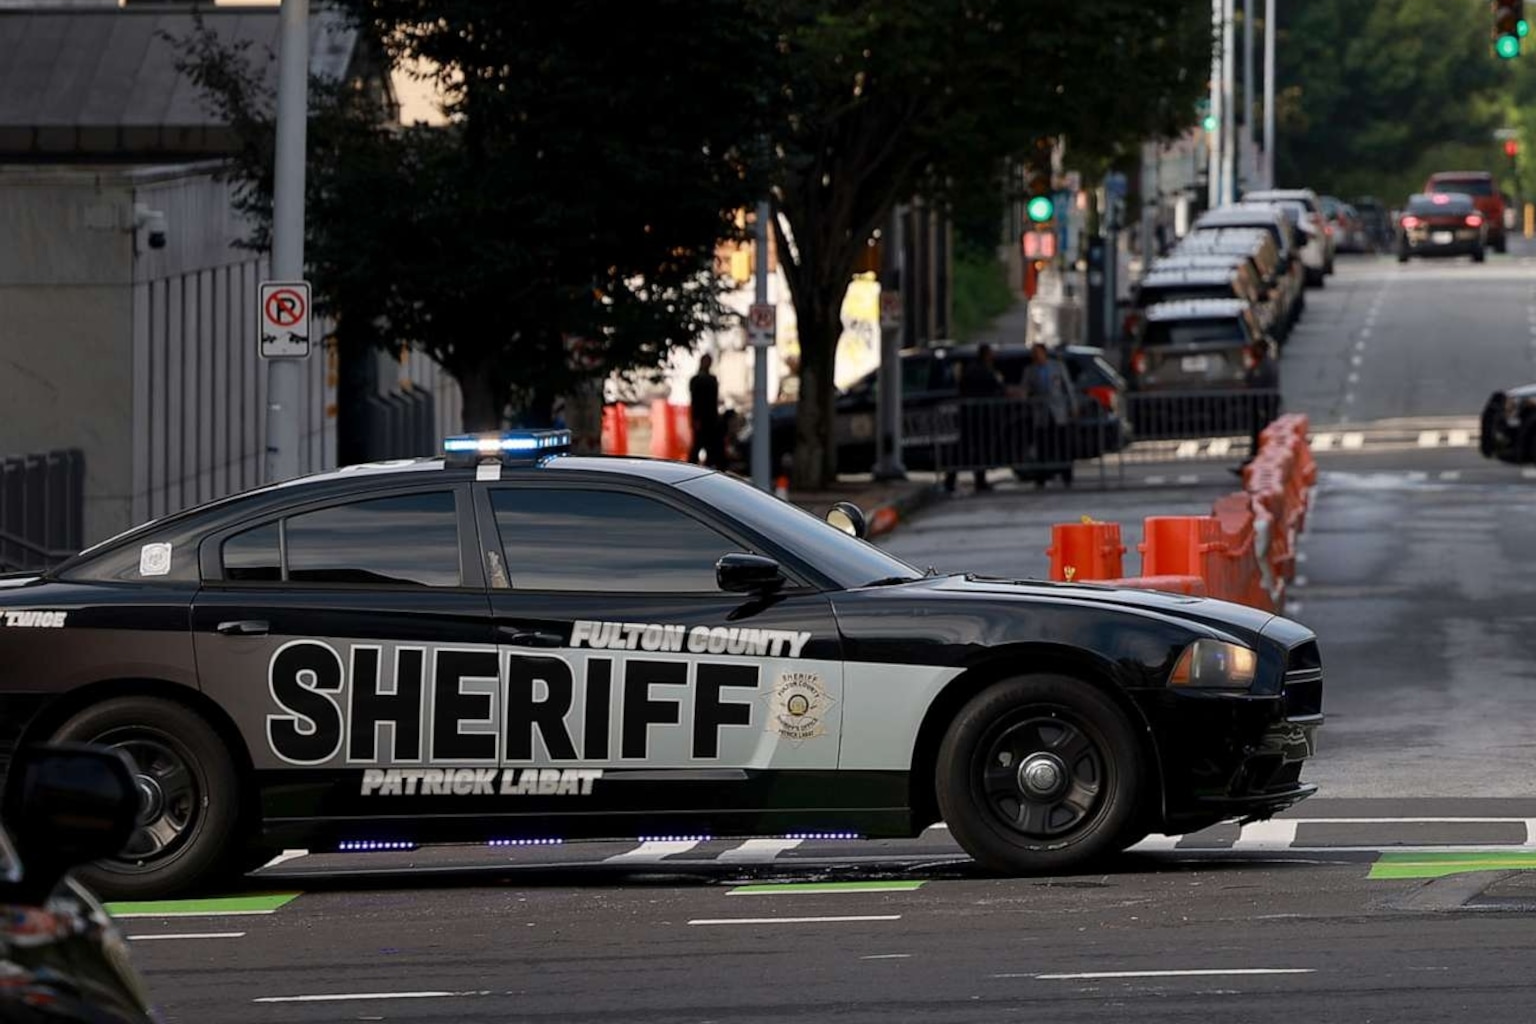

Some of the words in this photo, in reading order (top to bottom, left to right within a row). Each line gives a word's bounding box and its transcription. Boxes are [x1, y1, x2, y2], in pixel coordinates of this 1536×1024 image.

[5, 611, 68, 627] TWICE
[569, 620, 685, 652] FULTON
[687, 625, 811, 658] COUNTY
[266, 639, 761, 766] SHERIFF
[360, 768, 498, 795] PATRICK
[500, 768, 604, 795] LABAT
